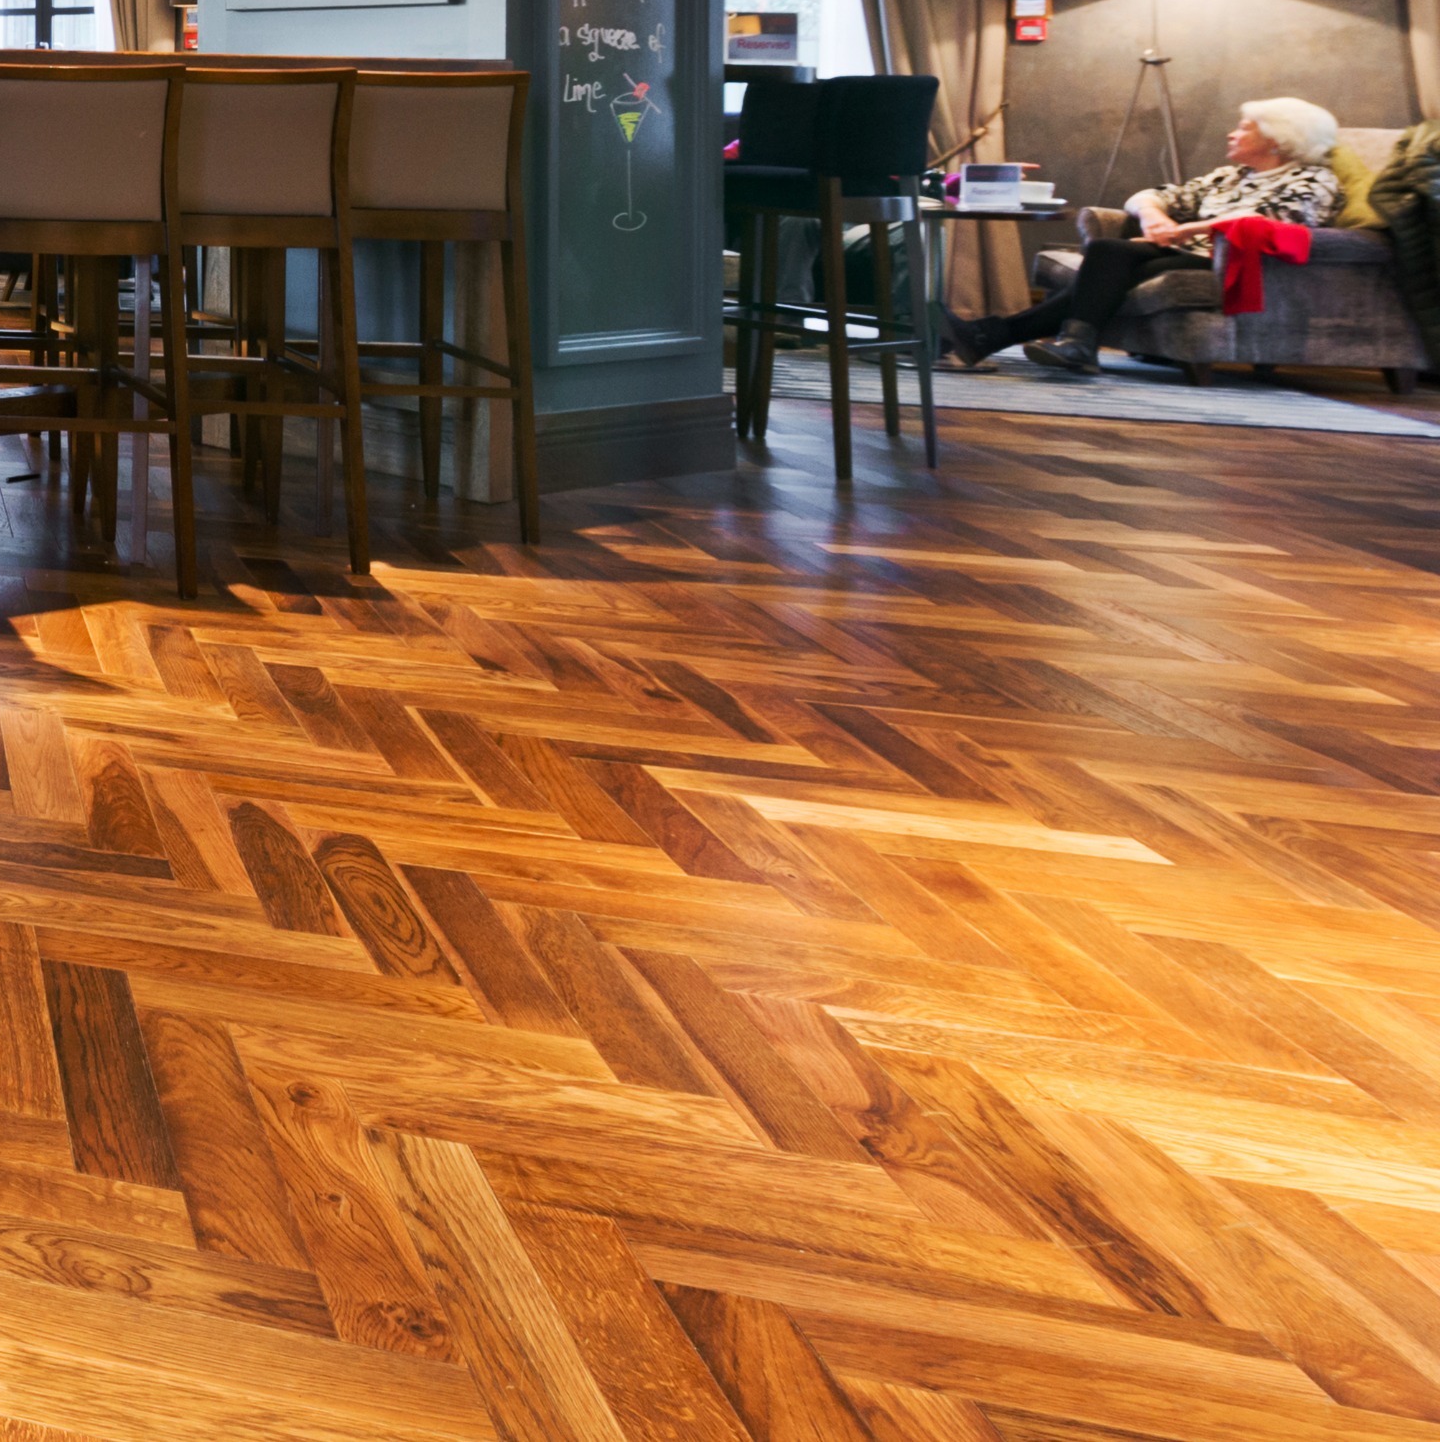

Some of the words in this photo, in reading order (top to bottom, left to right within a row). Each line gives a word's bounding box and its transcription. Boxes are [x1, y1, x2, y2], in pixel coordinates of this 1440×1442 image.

[559, 25, 571, 47] a
[647, 22, 667, 64] of
[563, 73, 607, 114] Lime
